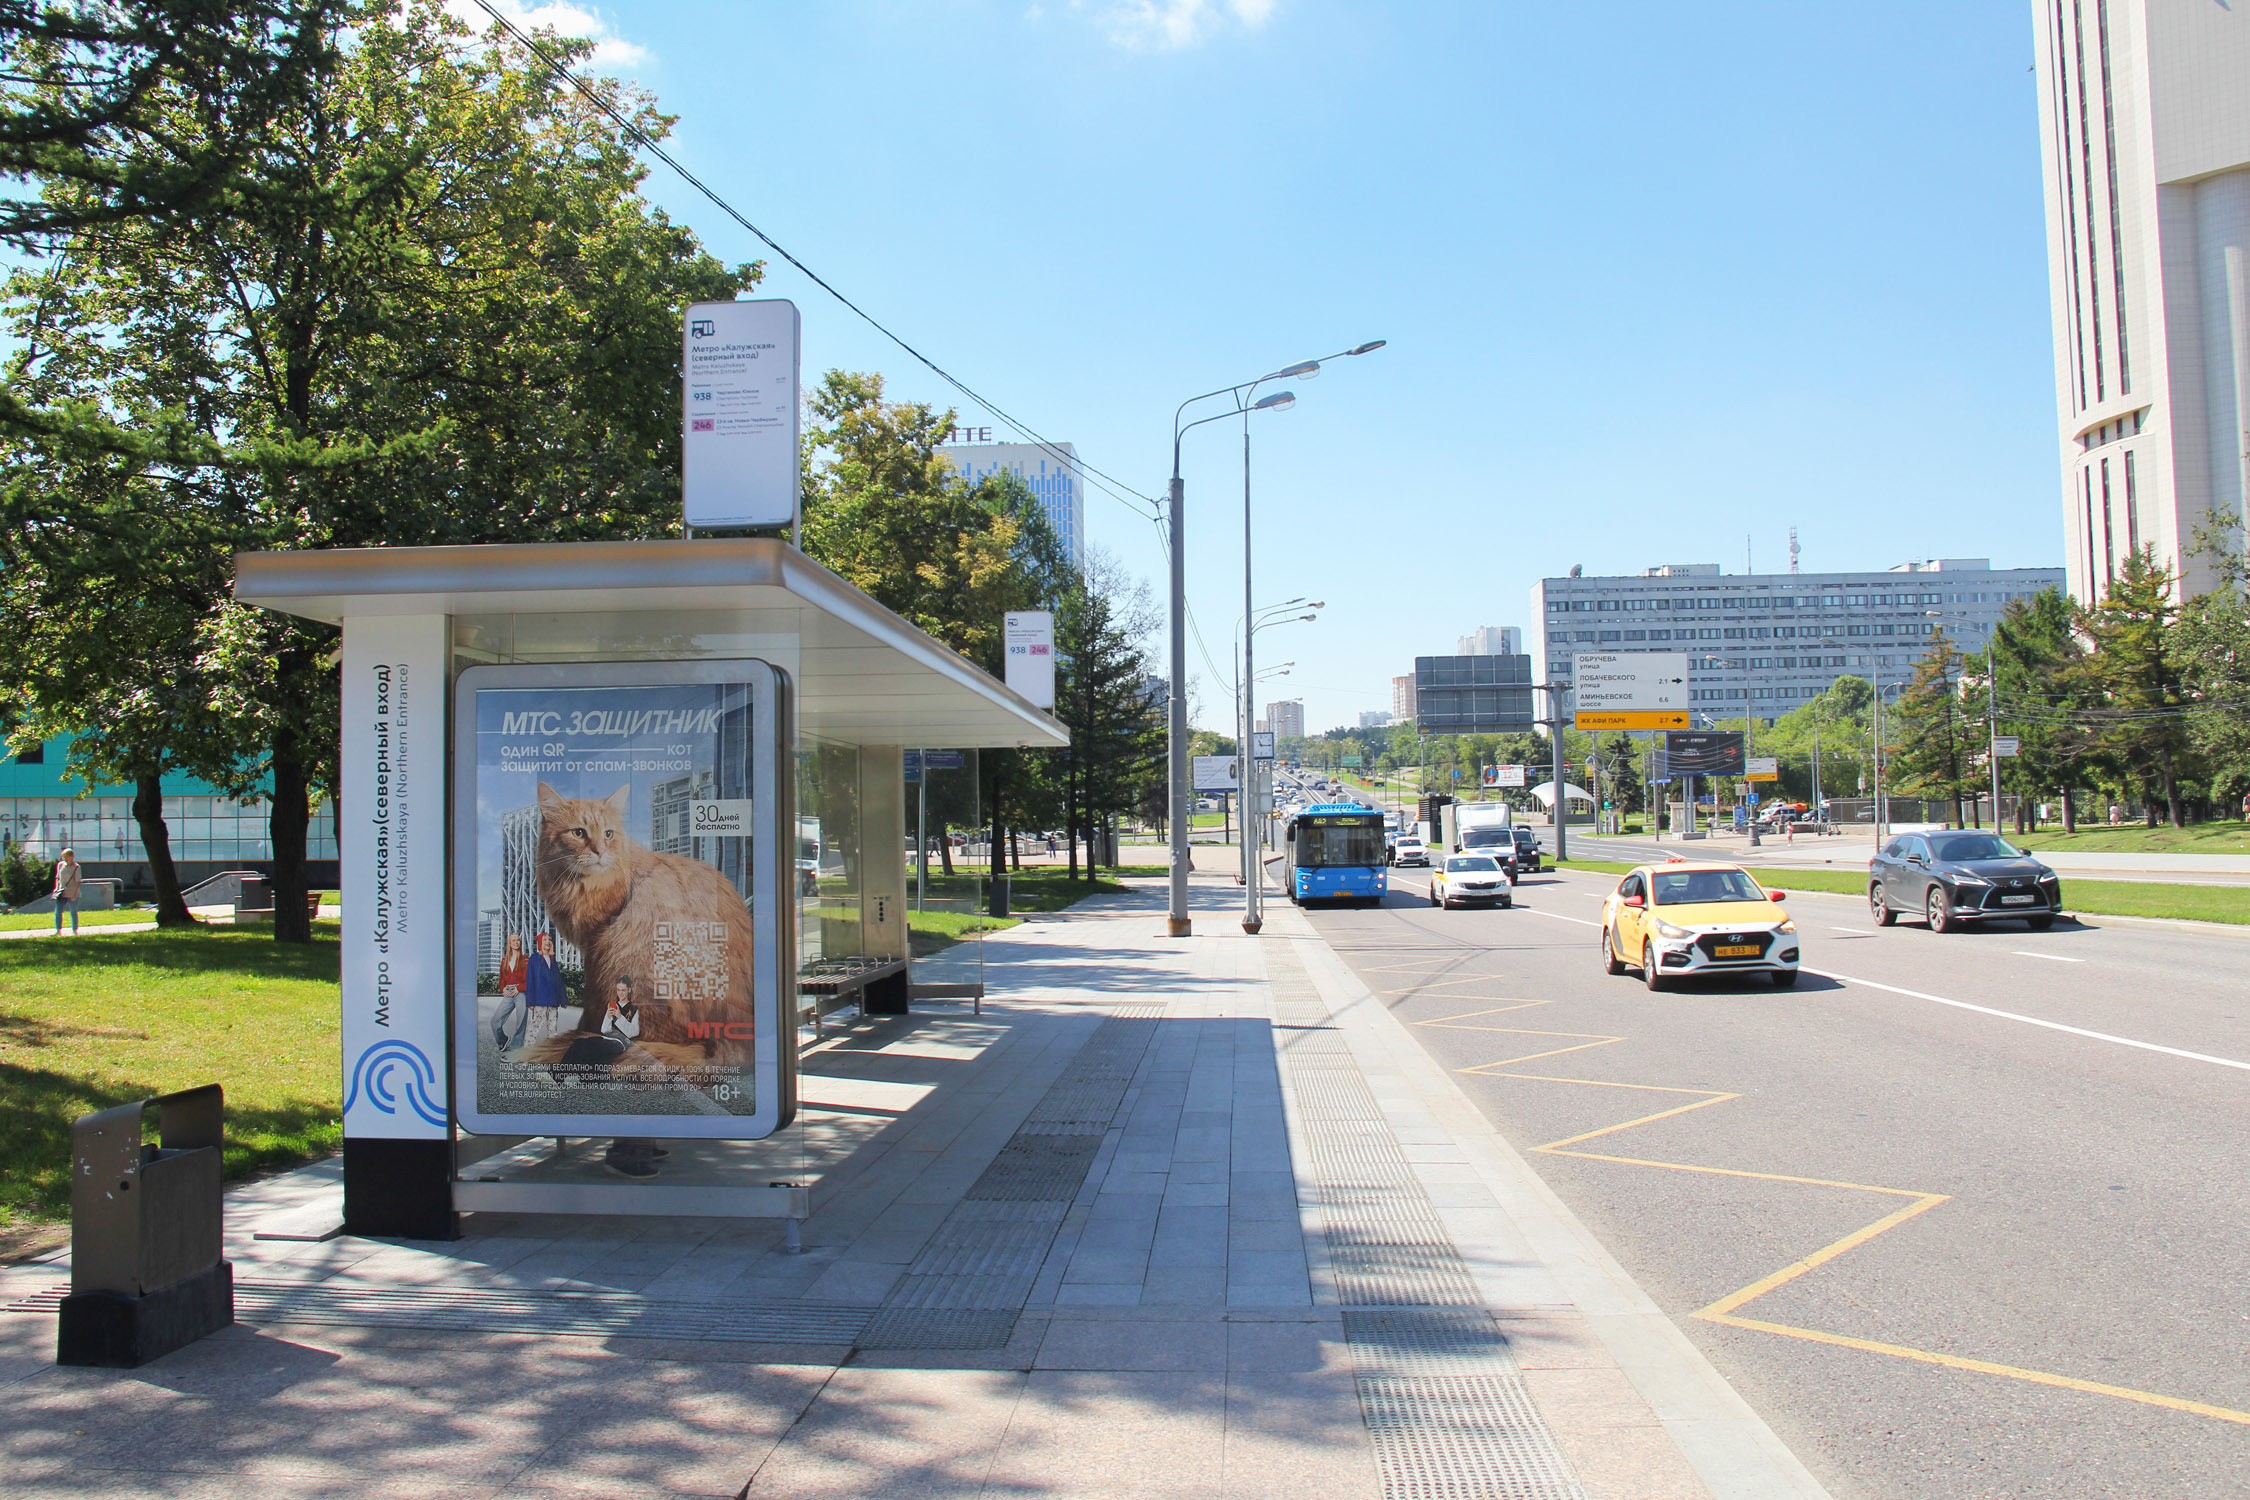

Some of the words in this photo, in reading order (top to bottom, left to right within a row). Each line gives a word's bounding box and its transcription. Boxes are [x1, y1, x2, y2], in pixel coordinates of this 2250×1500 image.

[692, 346, 719, 354] Метро
[721, 343, 776, 352] «Калужская»
[692, 353, 735, 362] (северный
[736, 351, 759, 361] вход)
[694, 392, 712, 401] 938
[694, 421, 712, 430] 246
[1010, 646, 1026, 654] 938
[1031, 646, 1047, 654] 246
[373, 664, 391, 715] вход)
[396, 663, 408, 727] Entrance)
[502, 711, 561, 736] МТС
[542, 743, 565, 757] QR
[396, 732, 408, 799] (Northern
[695, 805, 719, 822] 30
[719, 813, 740, 822] дней
[695, 823, 741, 831] бесплатно
[396, 803, 408, 884] Kaluzhskaya
[397, 888, 408, 933] Metro
[1731, 947, 1745, 955] 833
[374, 962, 392, 1028] Метро
[500, 1063, 513, 1072] ПОД
[528, 1063, 551, 1072] ДНЯМИ
[552, 1063, 593, 1072] БЕСПЛАТНО»
[594, 1063, 657, 1073] ПОДРАЗУМЕВАЕТСЯ
[658, 1066, 685, 1074] СКИДКА
[687, 1065, 704, 1073] 100%
[705, 1066, 710, 1074] В
[711, 1066, 741, 1074] ТЕЧЕНИЕ
[500, 1072, 525, 1081] ПЕРВЫХ
[527, 1072, 535, 1080] 30
[555, 1073, 611, 1081] ИСПОЛЬЗОВАНИЯ
[613, 1074, 639, 1082] УСЛУГИ.
[640, 1074, 652, 1082] ВСЕ
[654, 1074, 703, 1084] ПОДРОБНОСТИ
[704, 1075, 710, 1083] О
[711, 1075, 741, 1084] ПОРЯДКЕ
[505, 1082, 539, 1090] УСЛОВИЯХ
[540, 1082, 599, 1091] ПРЕДОСТАВЛЕНИЯ
[600, 1083, 623, 1092] ОПЦИИ
[624, 1084, 663, 1092] «ЗАЩИТНИК
[664, 1084, 689, 1092] ПРОМО
[712, 1084, 740, 1101] 18+
[500, 1090, 508, 1098] НА
